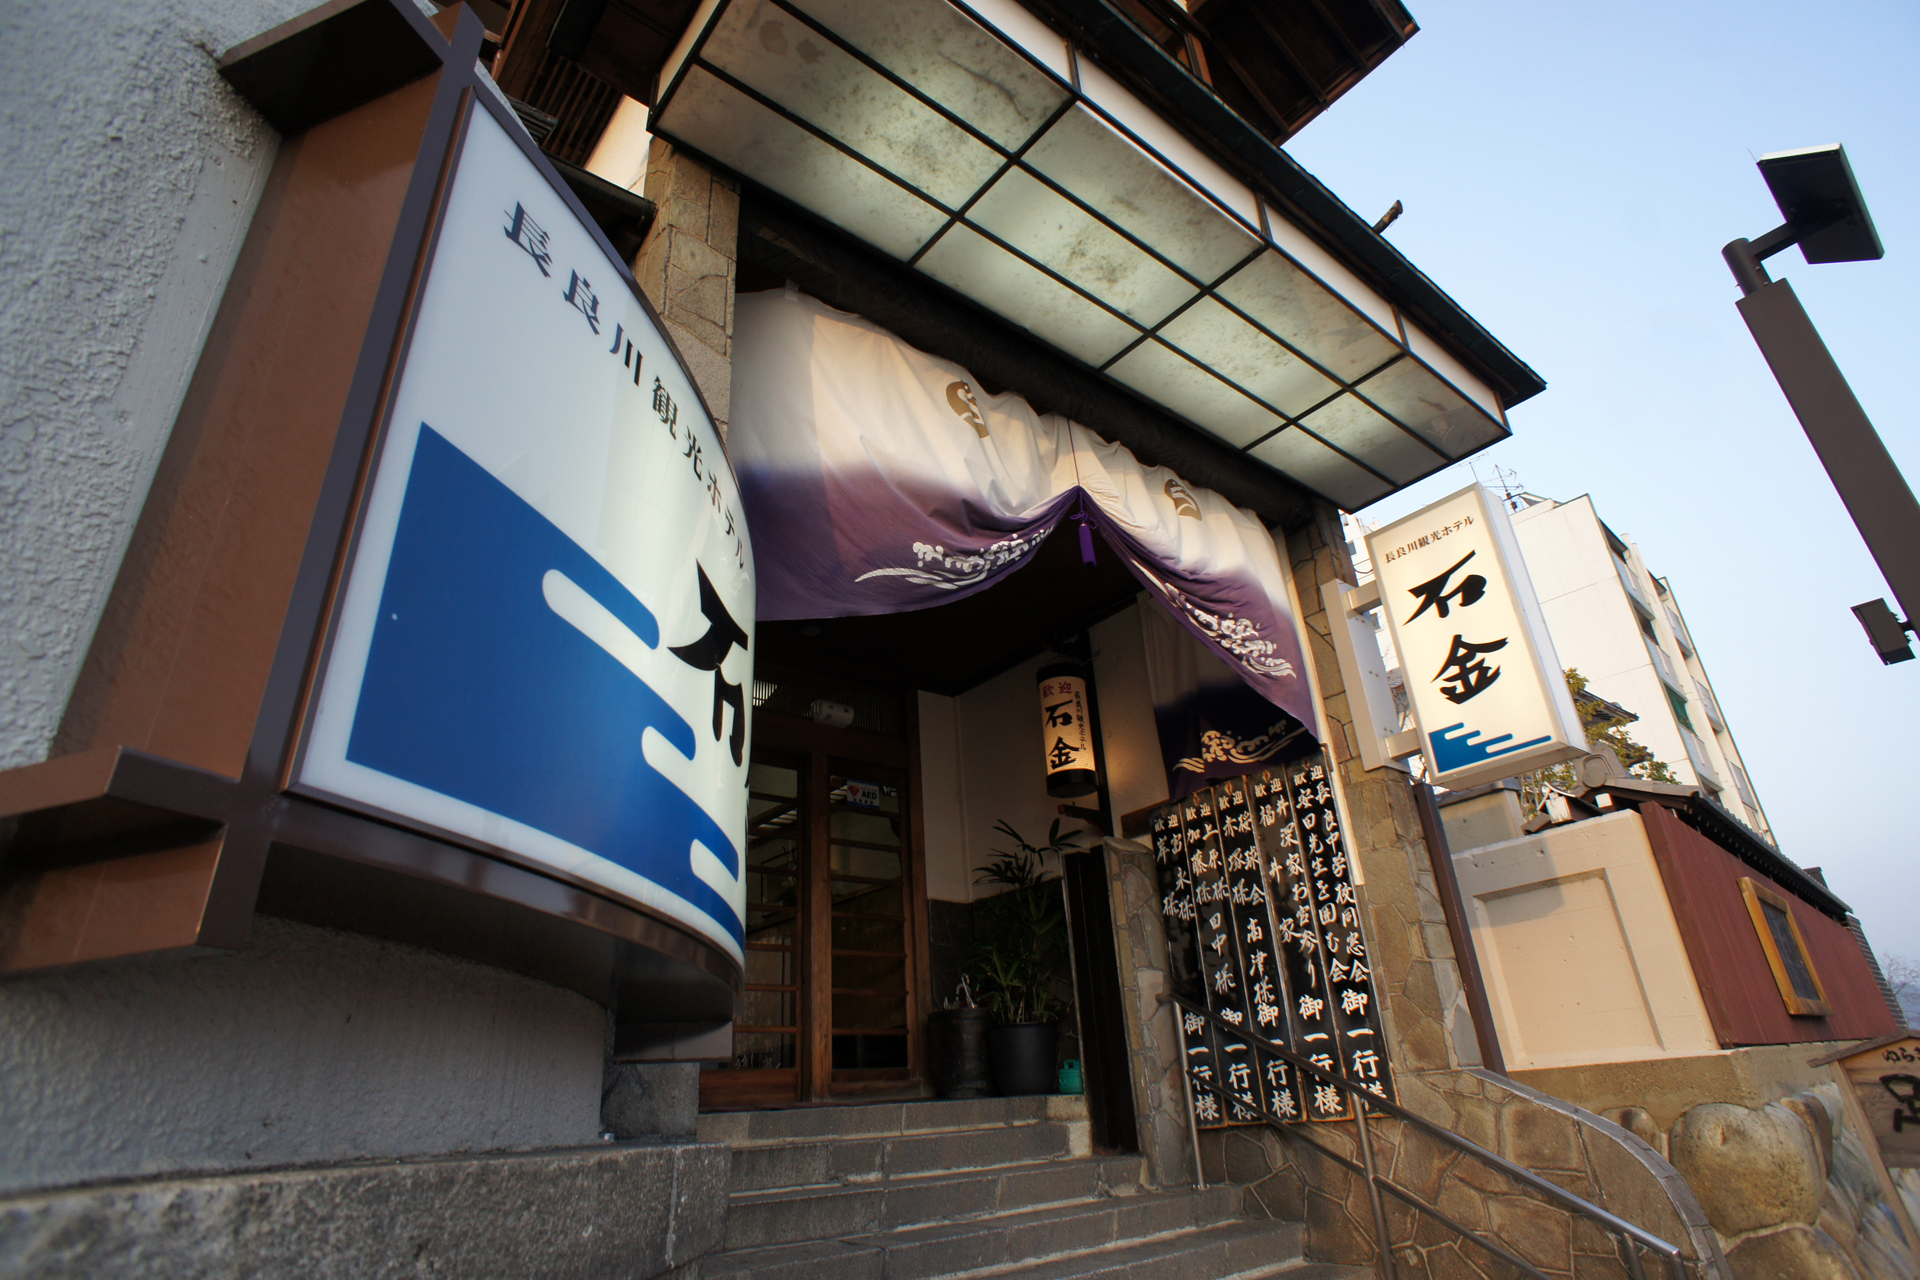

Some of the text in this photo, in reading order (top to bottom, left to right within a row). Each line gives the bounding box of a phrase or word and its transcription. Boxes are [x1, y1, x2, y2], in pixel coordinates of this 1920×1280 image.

[503, 201, 744, 569] 長良川観光ホテル
[1384, 515, 1475, 564] 長良川観光ホテル
[1402, 549, 1509, 704] 石金
[1045, 699, 1080, 770] 石金
[861, 790, 877, 801] AED
[1260, 804, 1302, 943] 福井家
[1296, 789, 1349, 982] 安田先生を囲む会
[1209, 912, 1236, 994] 田中様
